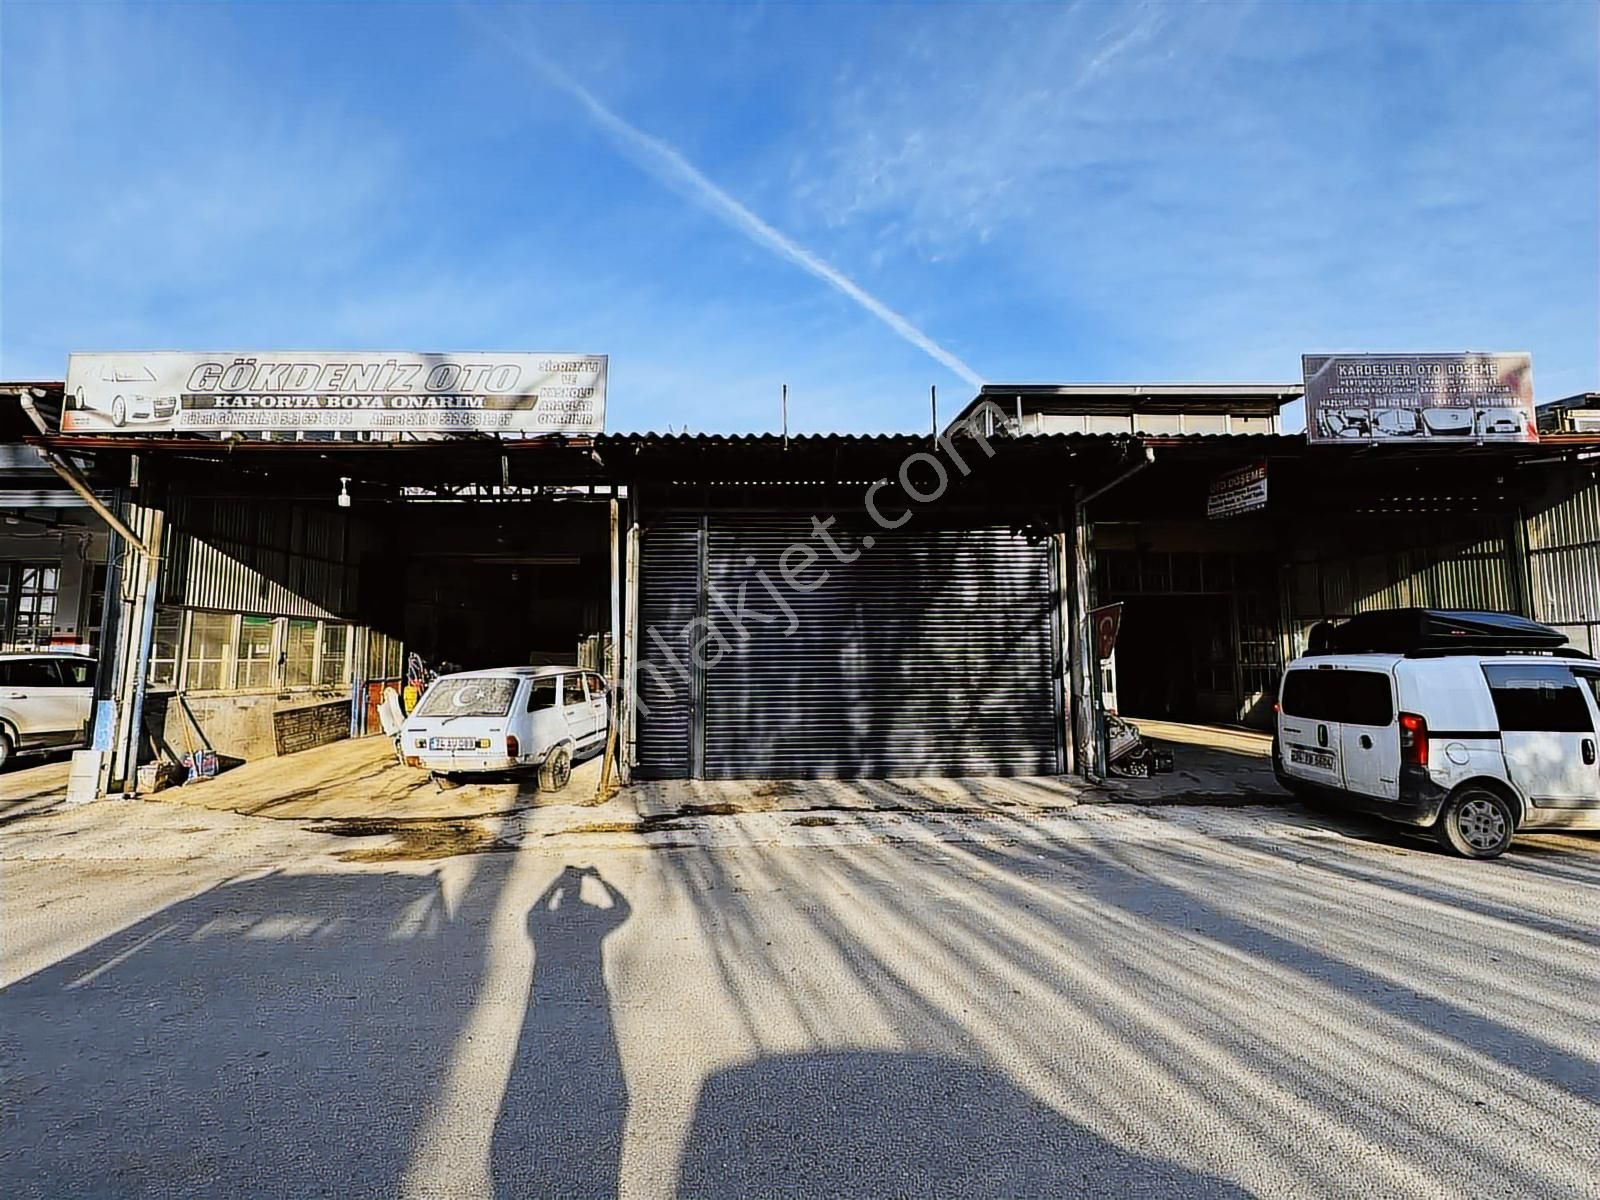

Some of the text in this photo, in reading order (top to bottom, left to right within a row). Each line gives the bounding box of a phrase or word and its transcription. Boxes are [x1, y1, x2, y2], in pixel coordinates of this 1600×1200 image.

[186, 358, 523, 392] GÖKDENİZ OTO
[1417, 363, 1441, 376] OTO
[213, 396, 485, 409] KAPORTA BOYA ONARIM
